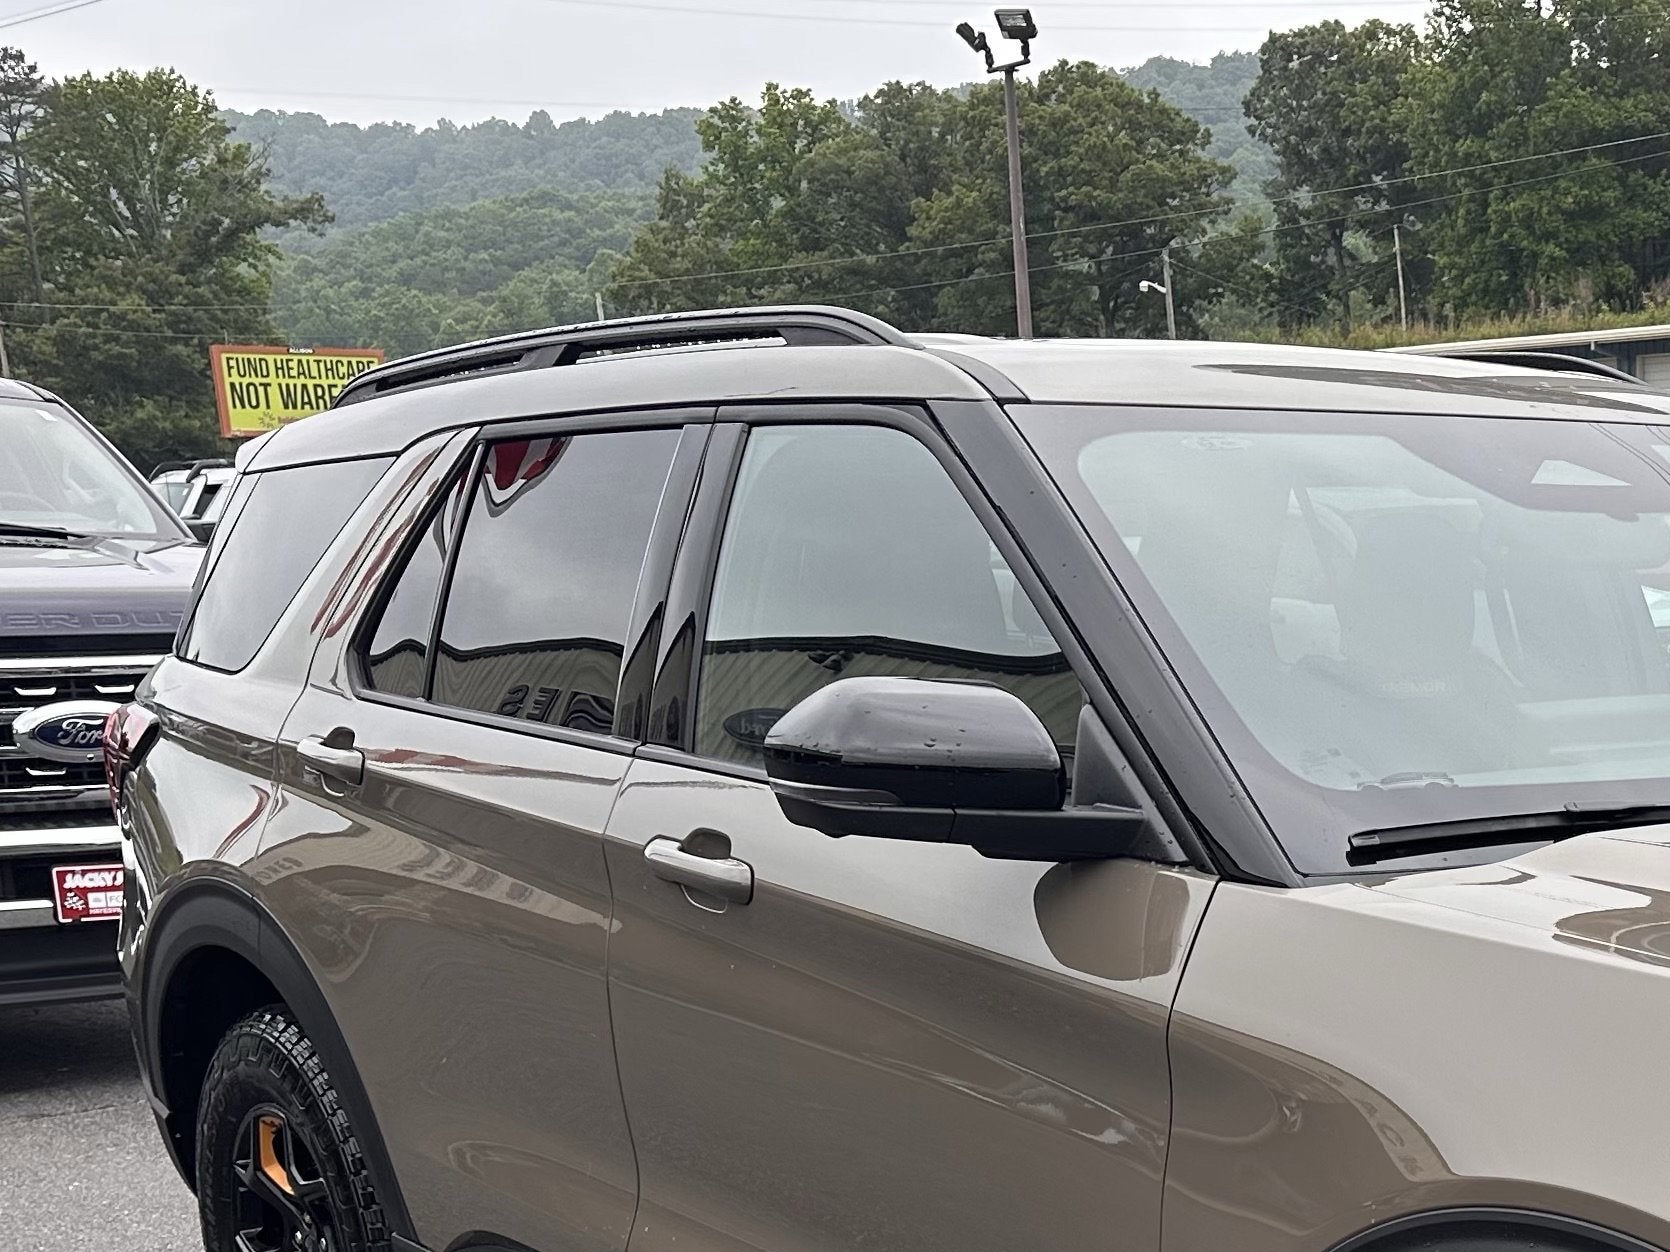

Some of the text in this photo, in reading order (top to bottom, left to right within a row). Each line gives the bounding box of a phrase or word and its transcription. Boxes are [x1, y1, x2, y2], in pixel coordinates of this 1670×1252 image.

[226, 356, 270, 379] FUND
[230, 382, 346, 410] NOT WARF
[2, 612, 81, 629] ER
[57, 718, 106, 746] For
